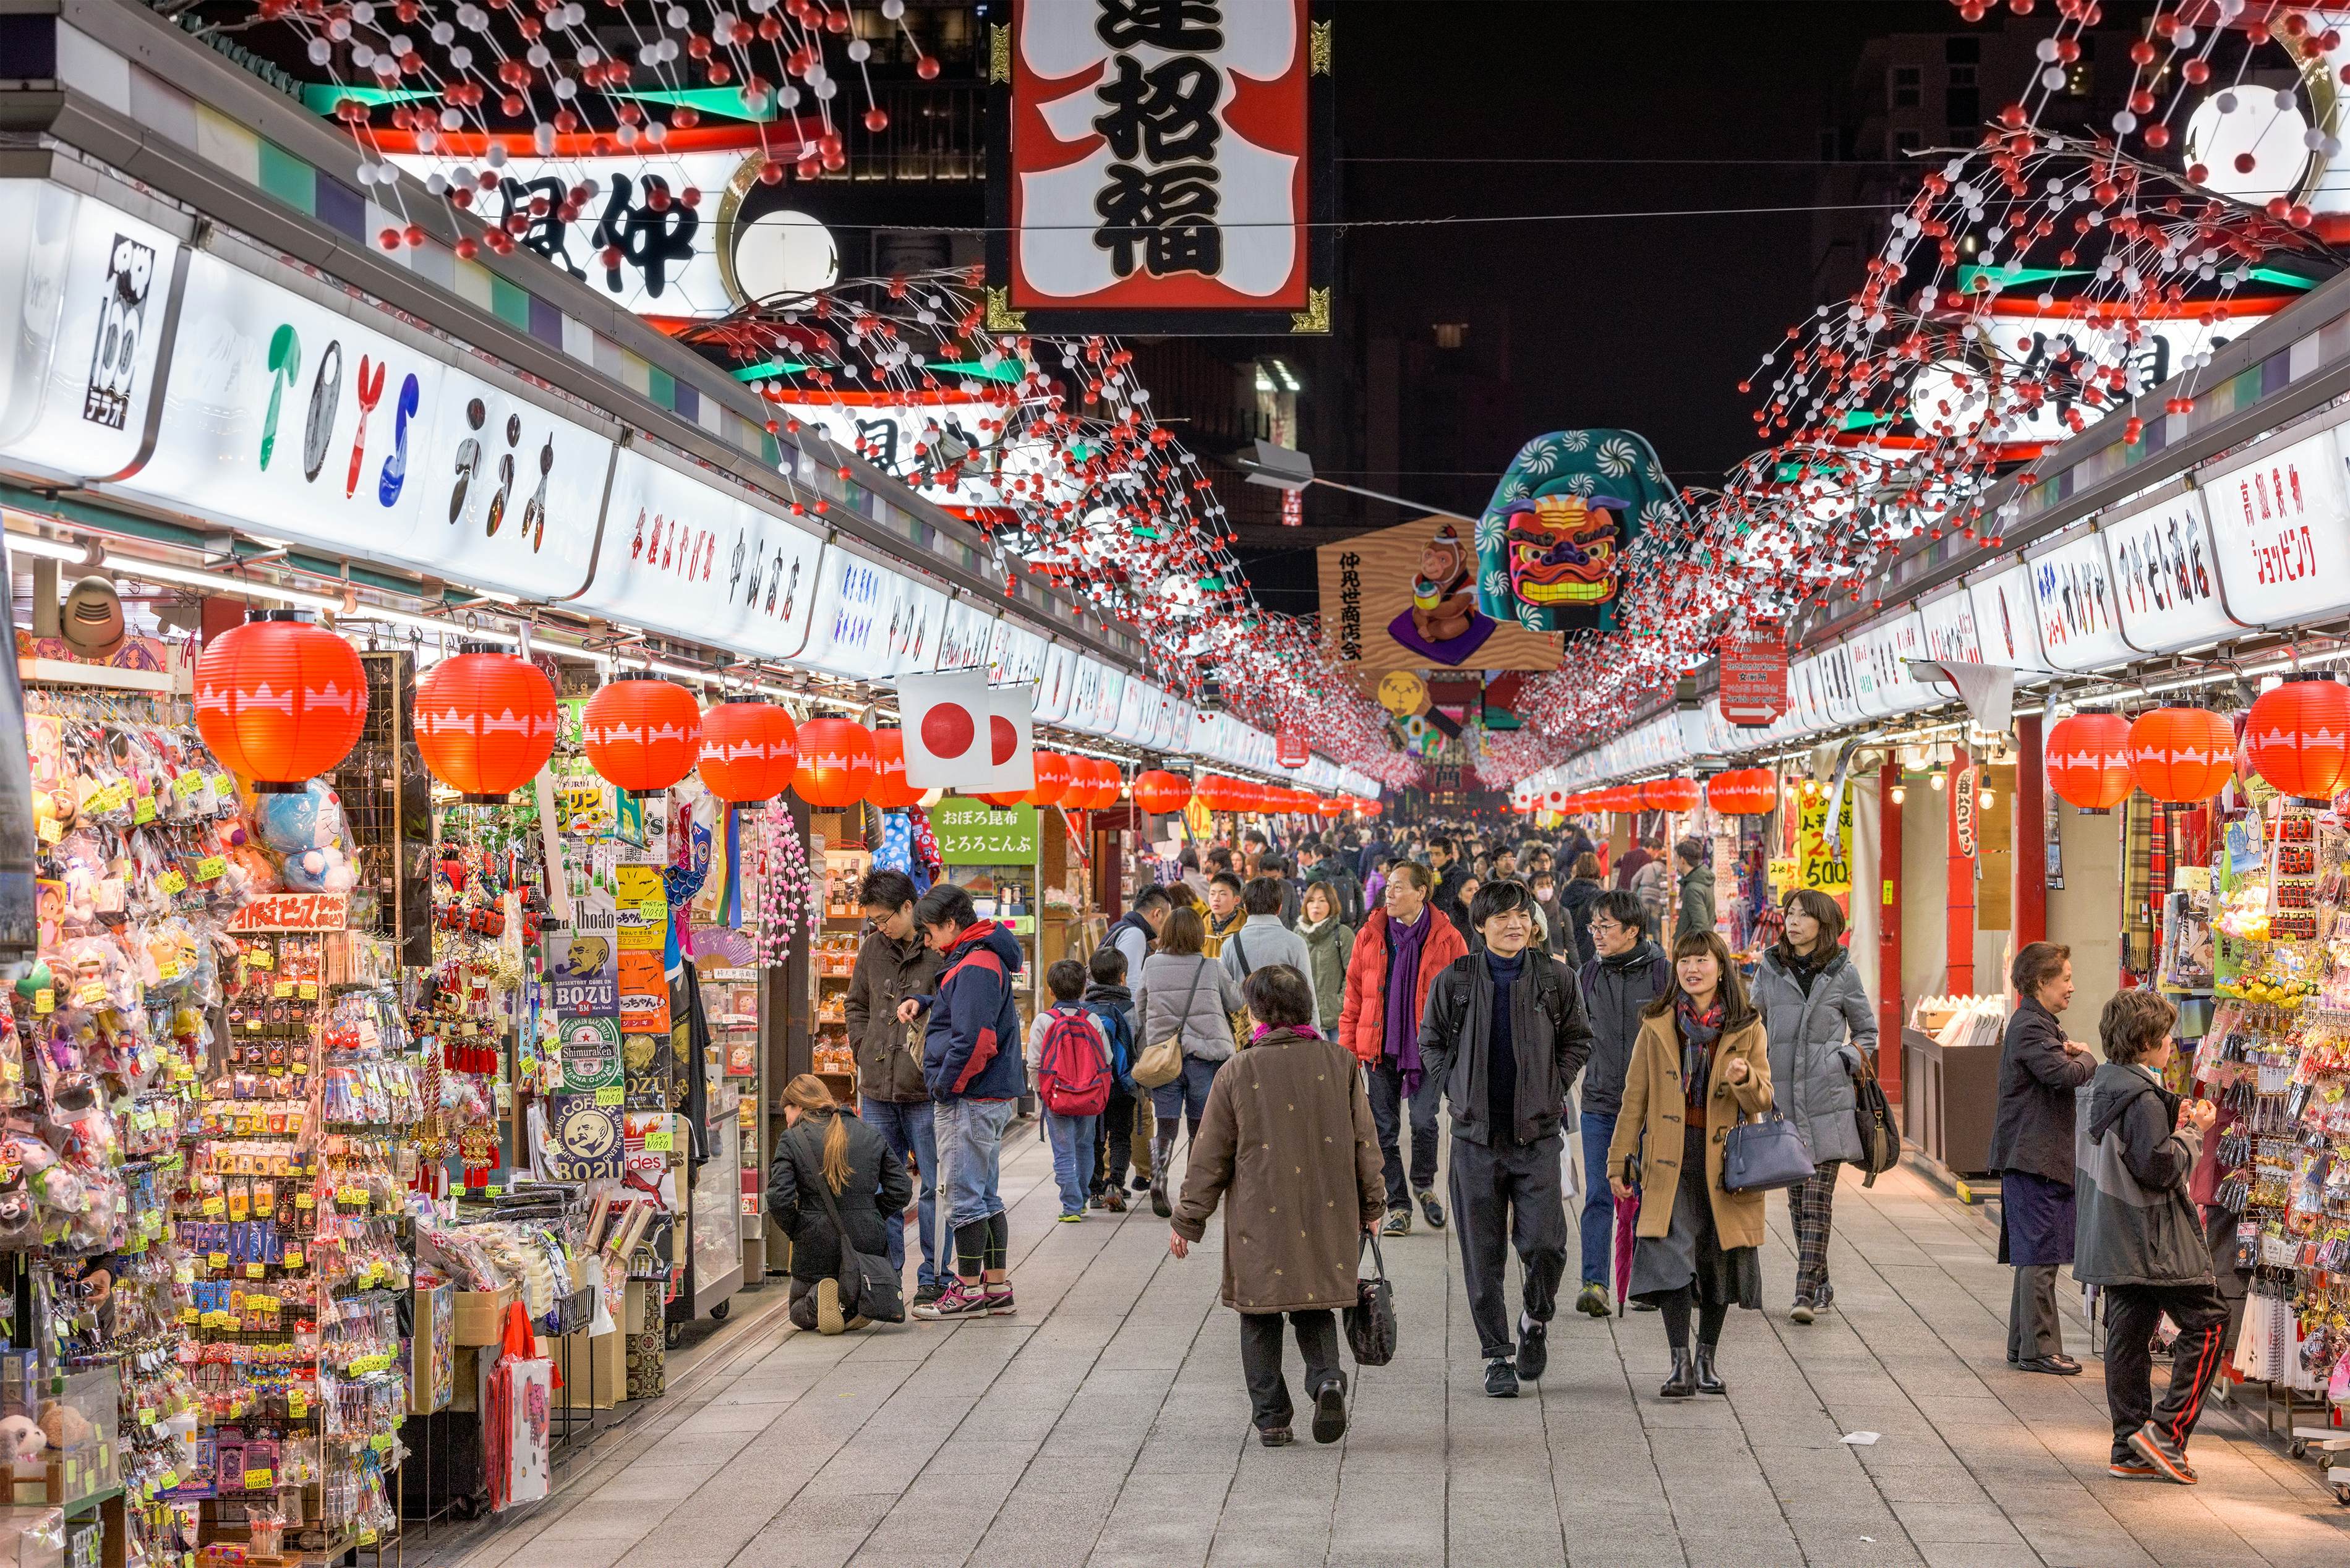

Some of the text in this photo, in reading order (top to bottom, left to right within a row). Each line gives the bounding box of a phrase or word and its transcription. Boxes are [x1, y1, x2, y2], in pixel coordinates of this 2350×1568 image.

[87, 391, 124, 427] テラオ
[259, 323, 419, 508] TOYS
[1340, 552, 1362, 661] 仲見世商店会
[942, 811, 1019, 826] おぼろ昆布
[625, 846, 642, 861] 馬場
[642, 908, 665, 917] ¥1050
[555, 986, 613, 1005] BOZU
[579, 1004, 590, 1012] BM
[562, 1018, 588, 1040] SHIMURAKEN
[588, 1018, 602, 1027] BAKA
[563, 1046, 612, 1058] Shimuraken
[565, 1065, 612, 1083] HENNA OJISAN
[597, 1094, 621, 1103] ¥1050
[647, 1140, 669, 1149] ¥1050
